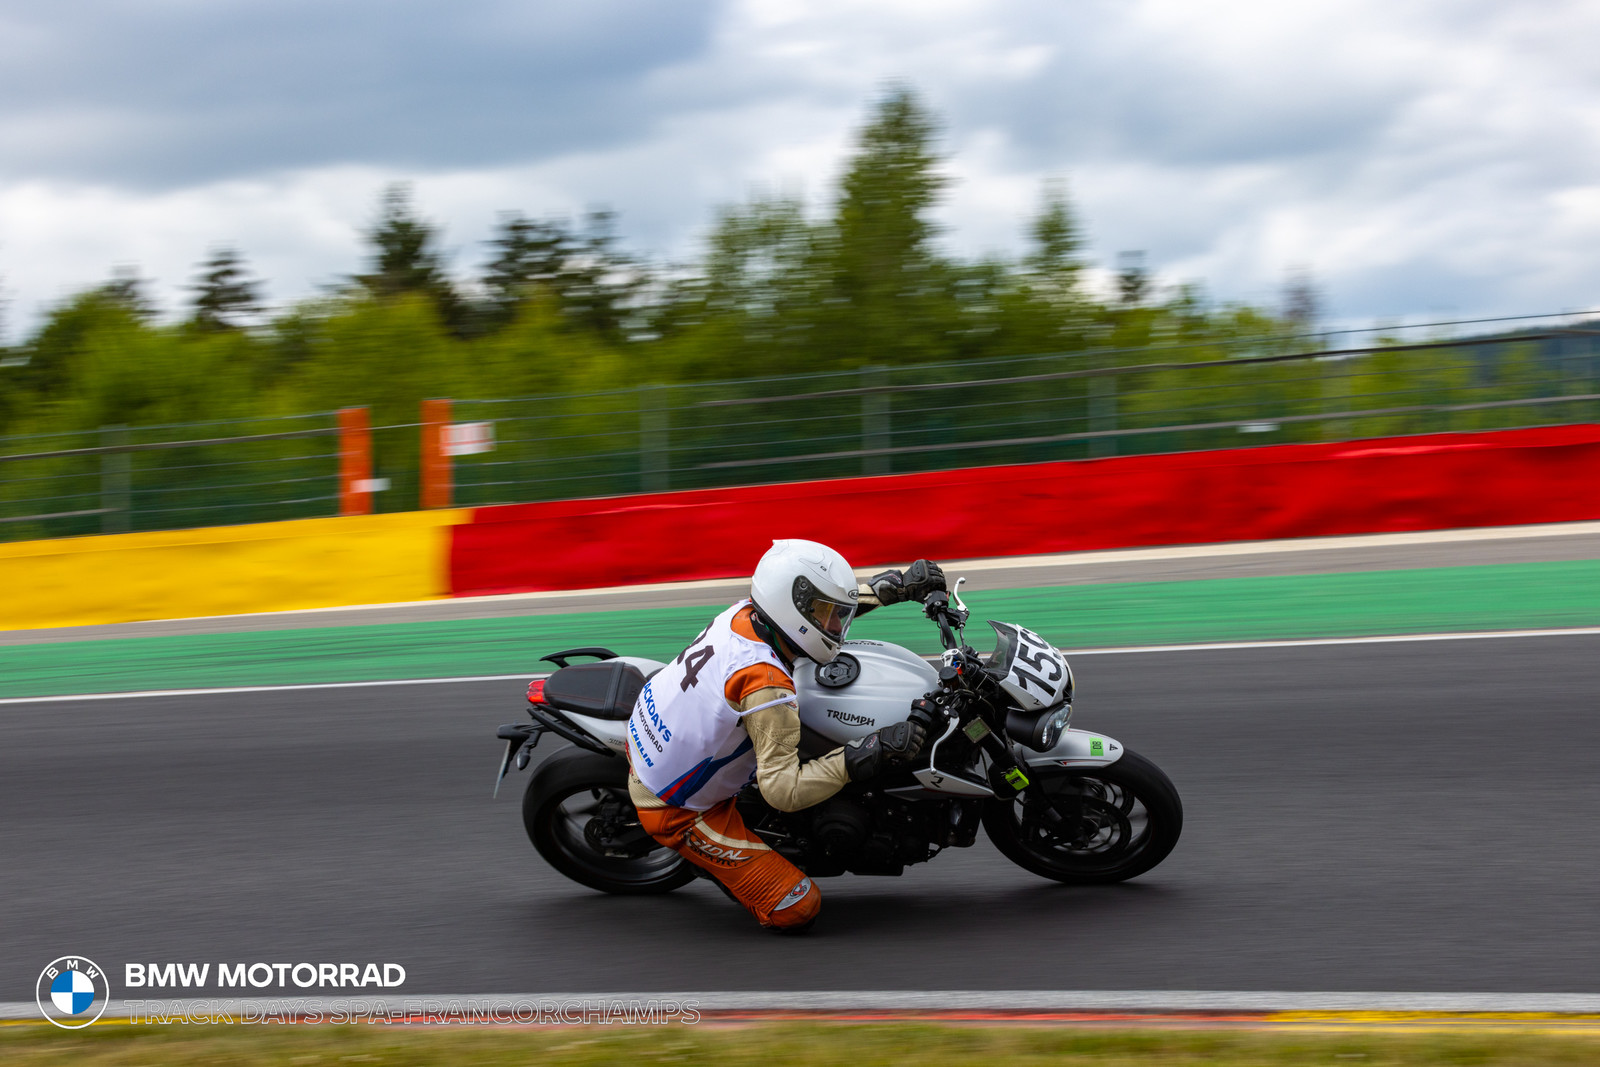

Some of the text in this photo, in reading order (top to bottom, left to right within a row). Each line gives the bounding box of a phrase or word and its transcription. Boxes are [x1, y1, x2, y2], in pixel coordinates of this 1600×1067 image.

[639, 708, 663, 753] MOTORRAD
[643, 679, 672, 743] ACKDAYS
[827, 709, 875, 727] TRIUMPH
